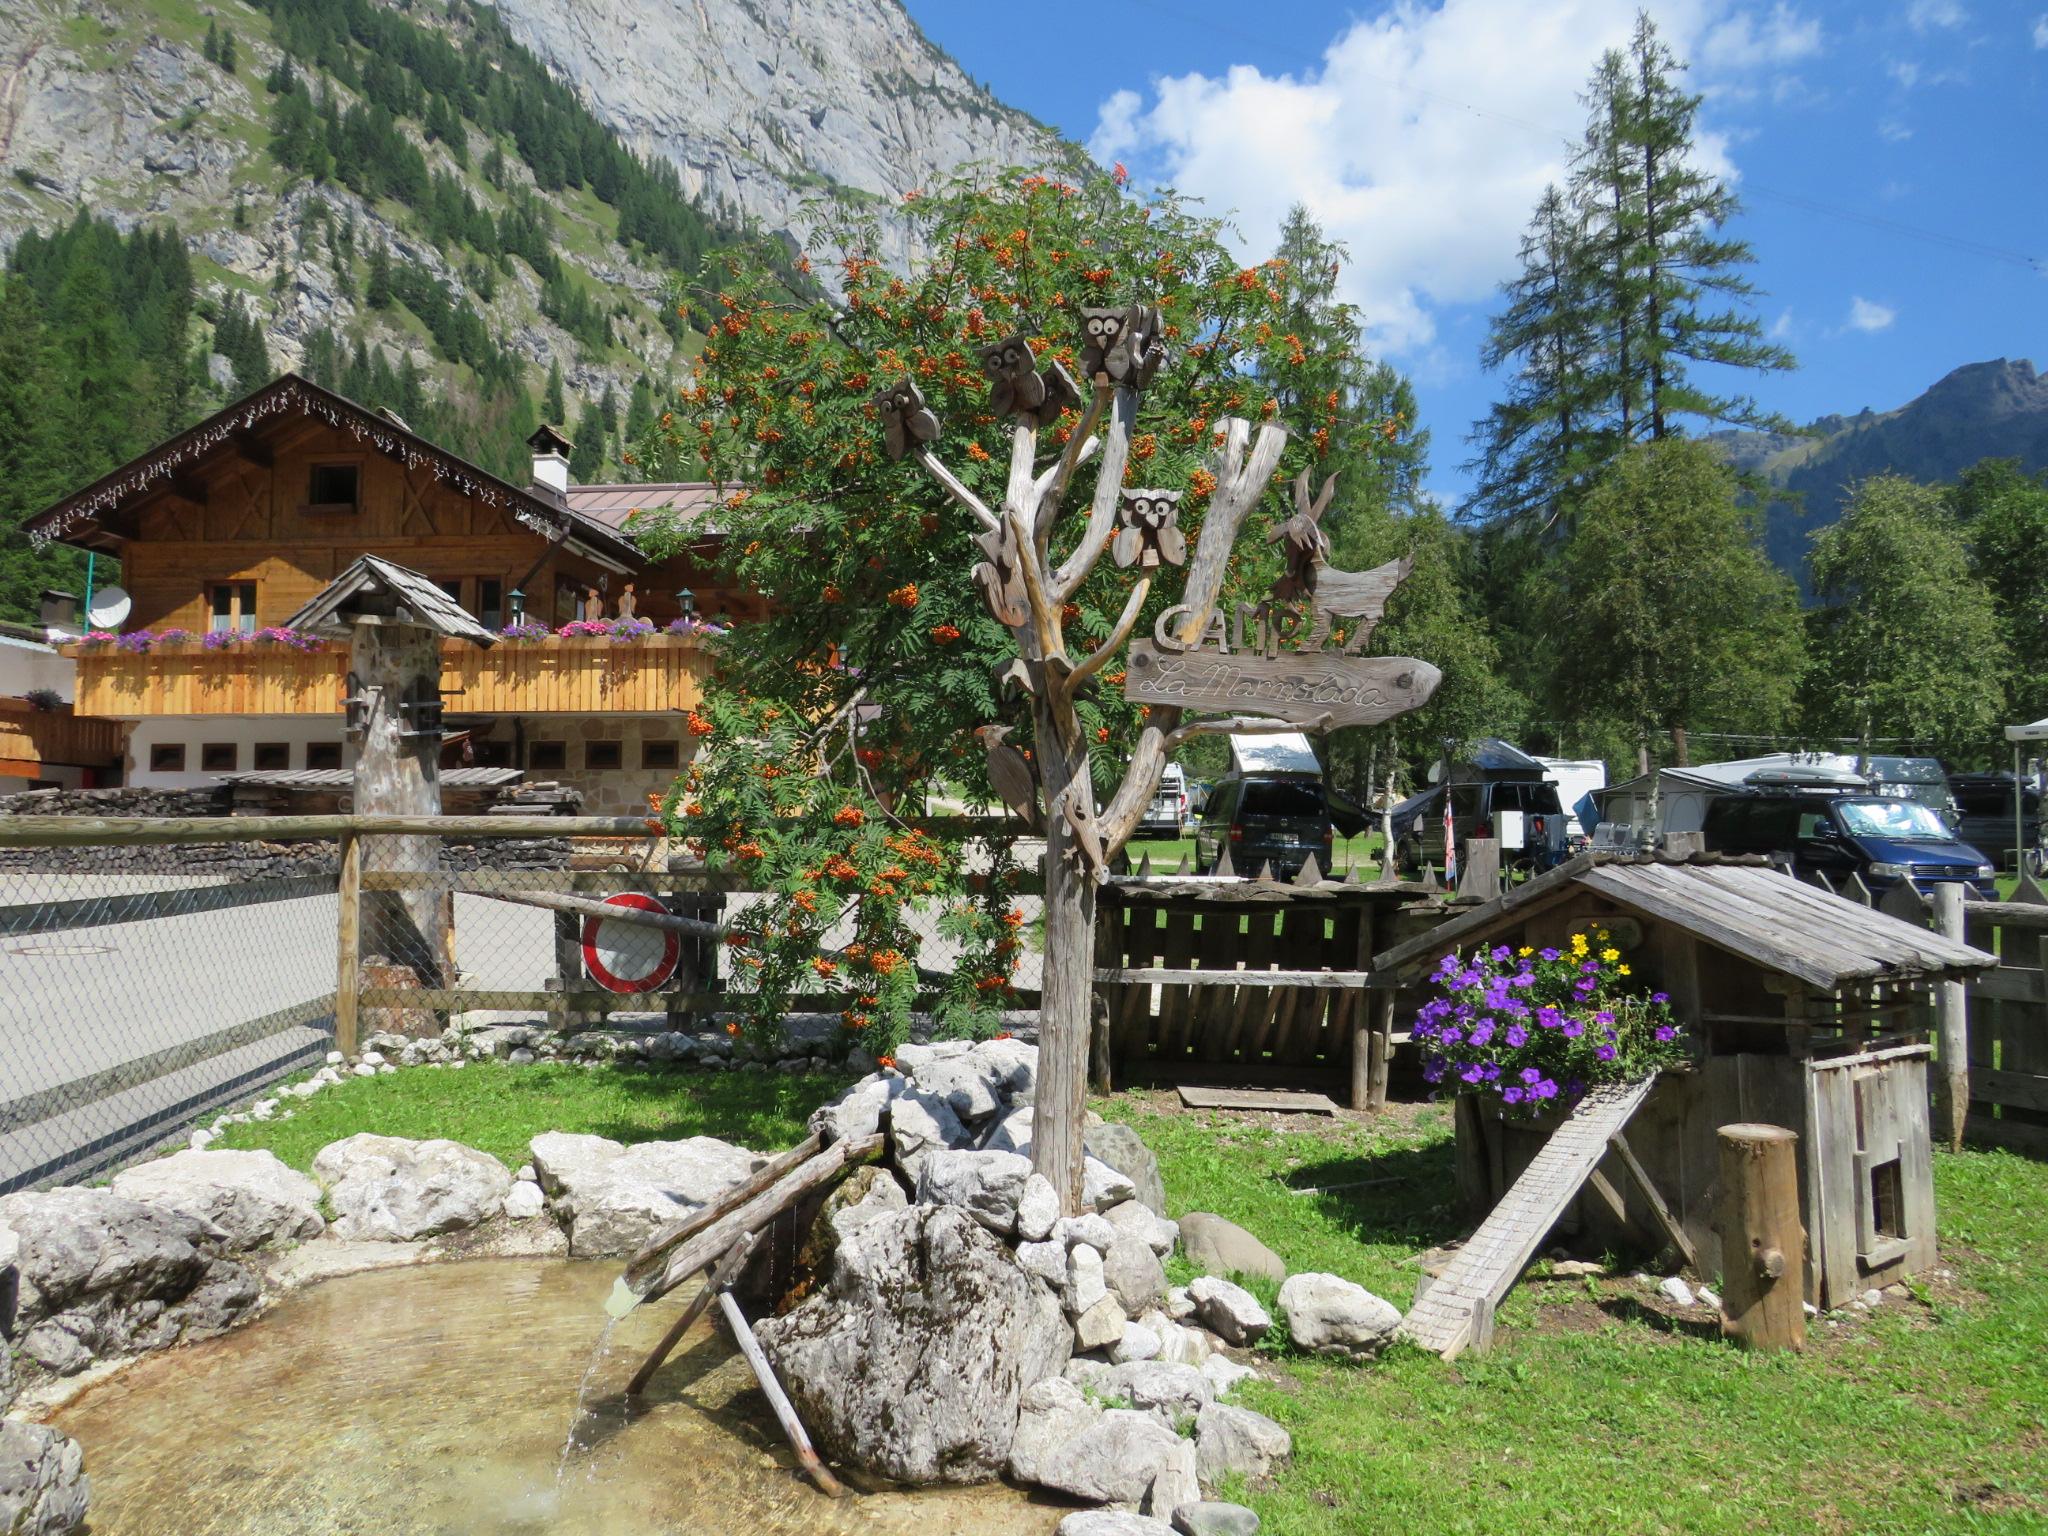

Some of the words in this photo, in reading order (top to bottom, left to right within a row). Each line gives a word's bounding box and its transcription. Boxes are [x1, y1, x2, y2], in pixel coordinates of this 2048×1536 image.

[1154, 602, 1302, 658] CAMP
[1140, 656, 1194, 696] La
[1198, 664, 1388, 706] Marmolada
